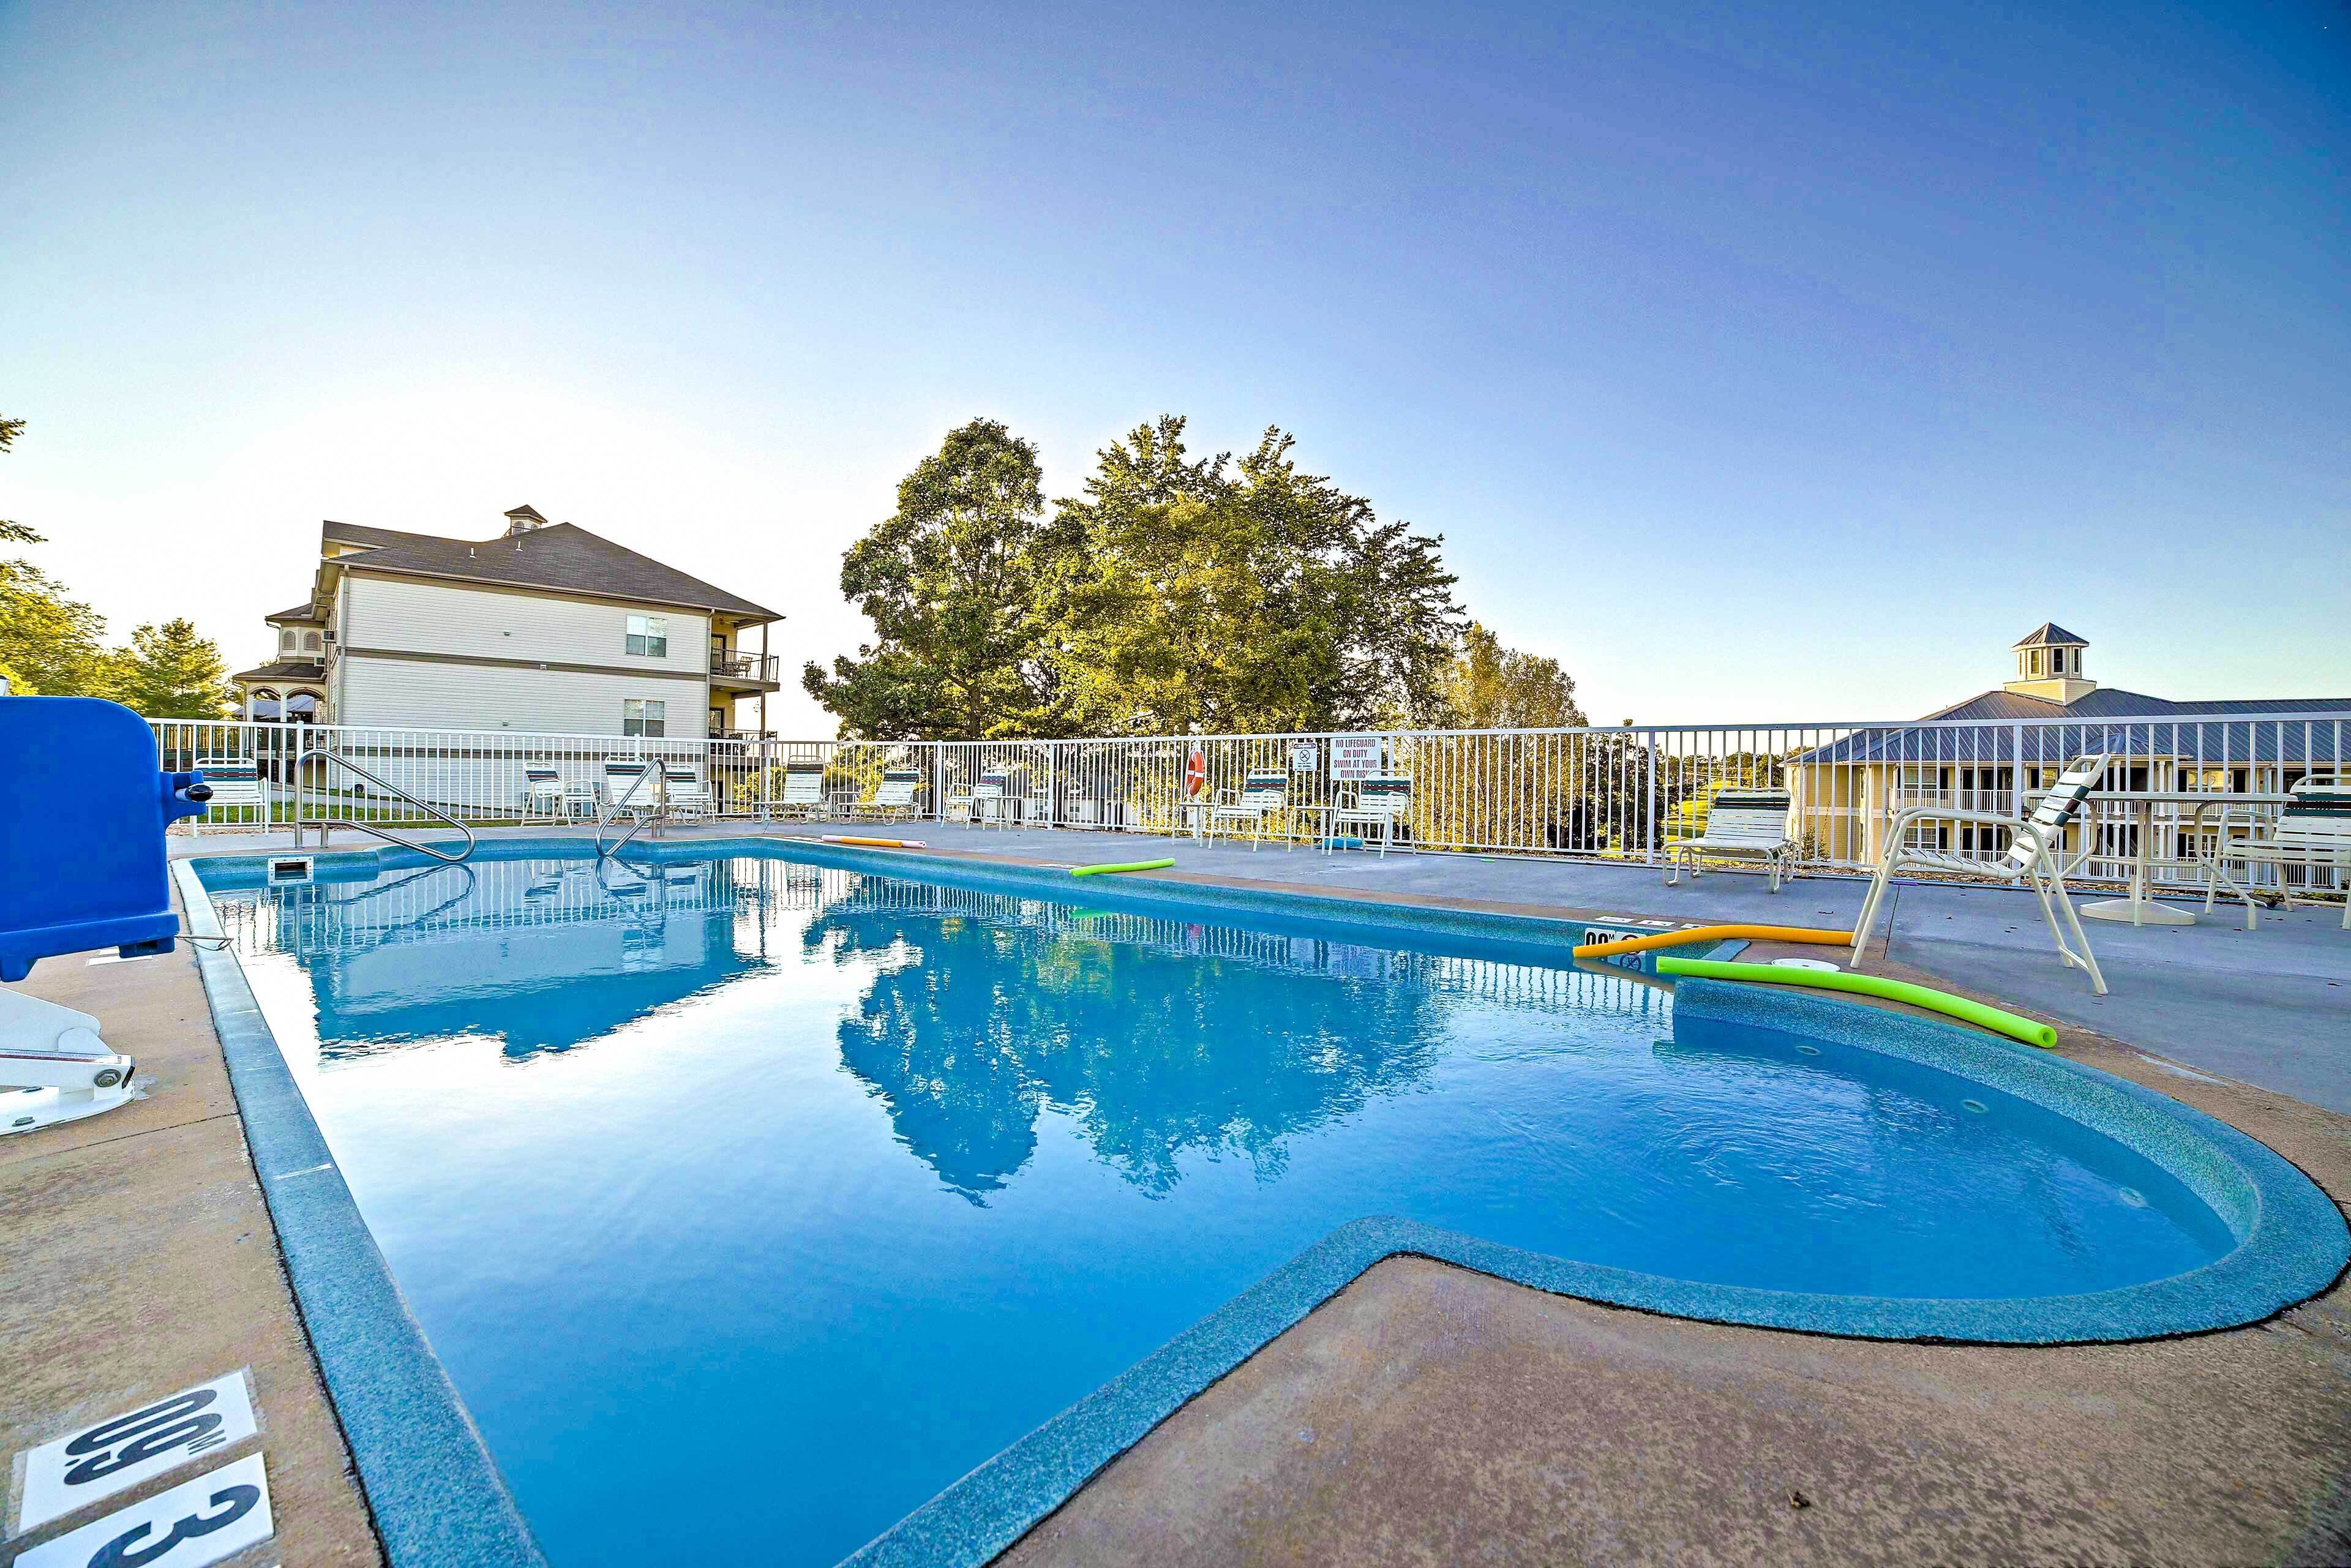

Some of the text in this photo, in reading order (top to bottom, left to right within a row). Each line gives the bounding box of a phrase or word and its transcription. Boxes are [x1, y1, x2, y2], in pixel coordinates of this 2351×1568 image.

[1335, 739, 1376, 748] NO LIFEGUARD
[1343, 749, 1368, 758] ON DUTY
[1333, 759, 1377, 768] SWIM AT YOUR
[1340, 770, 1354, 778] OWN
[87, 1484, 260, 1568] 3
